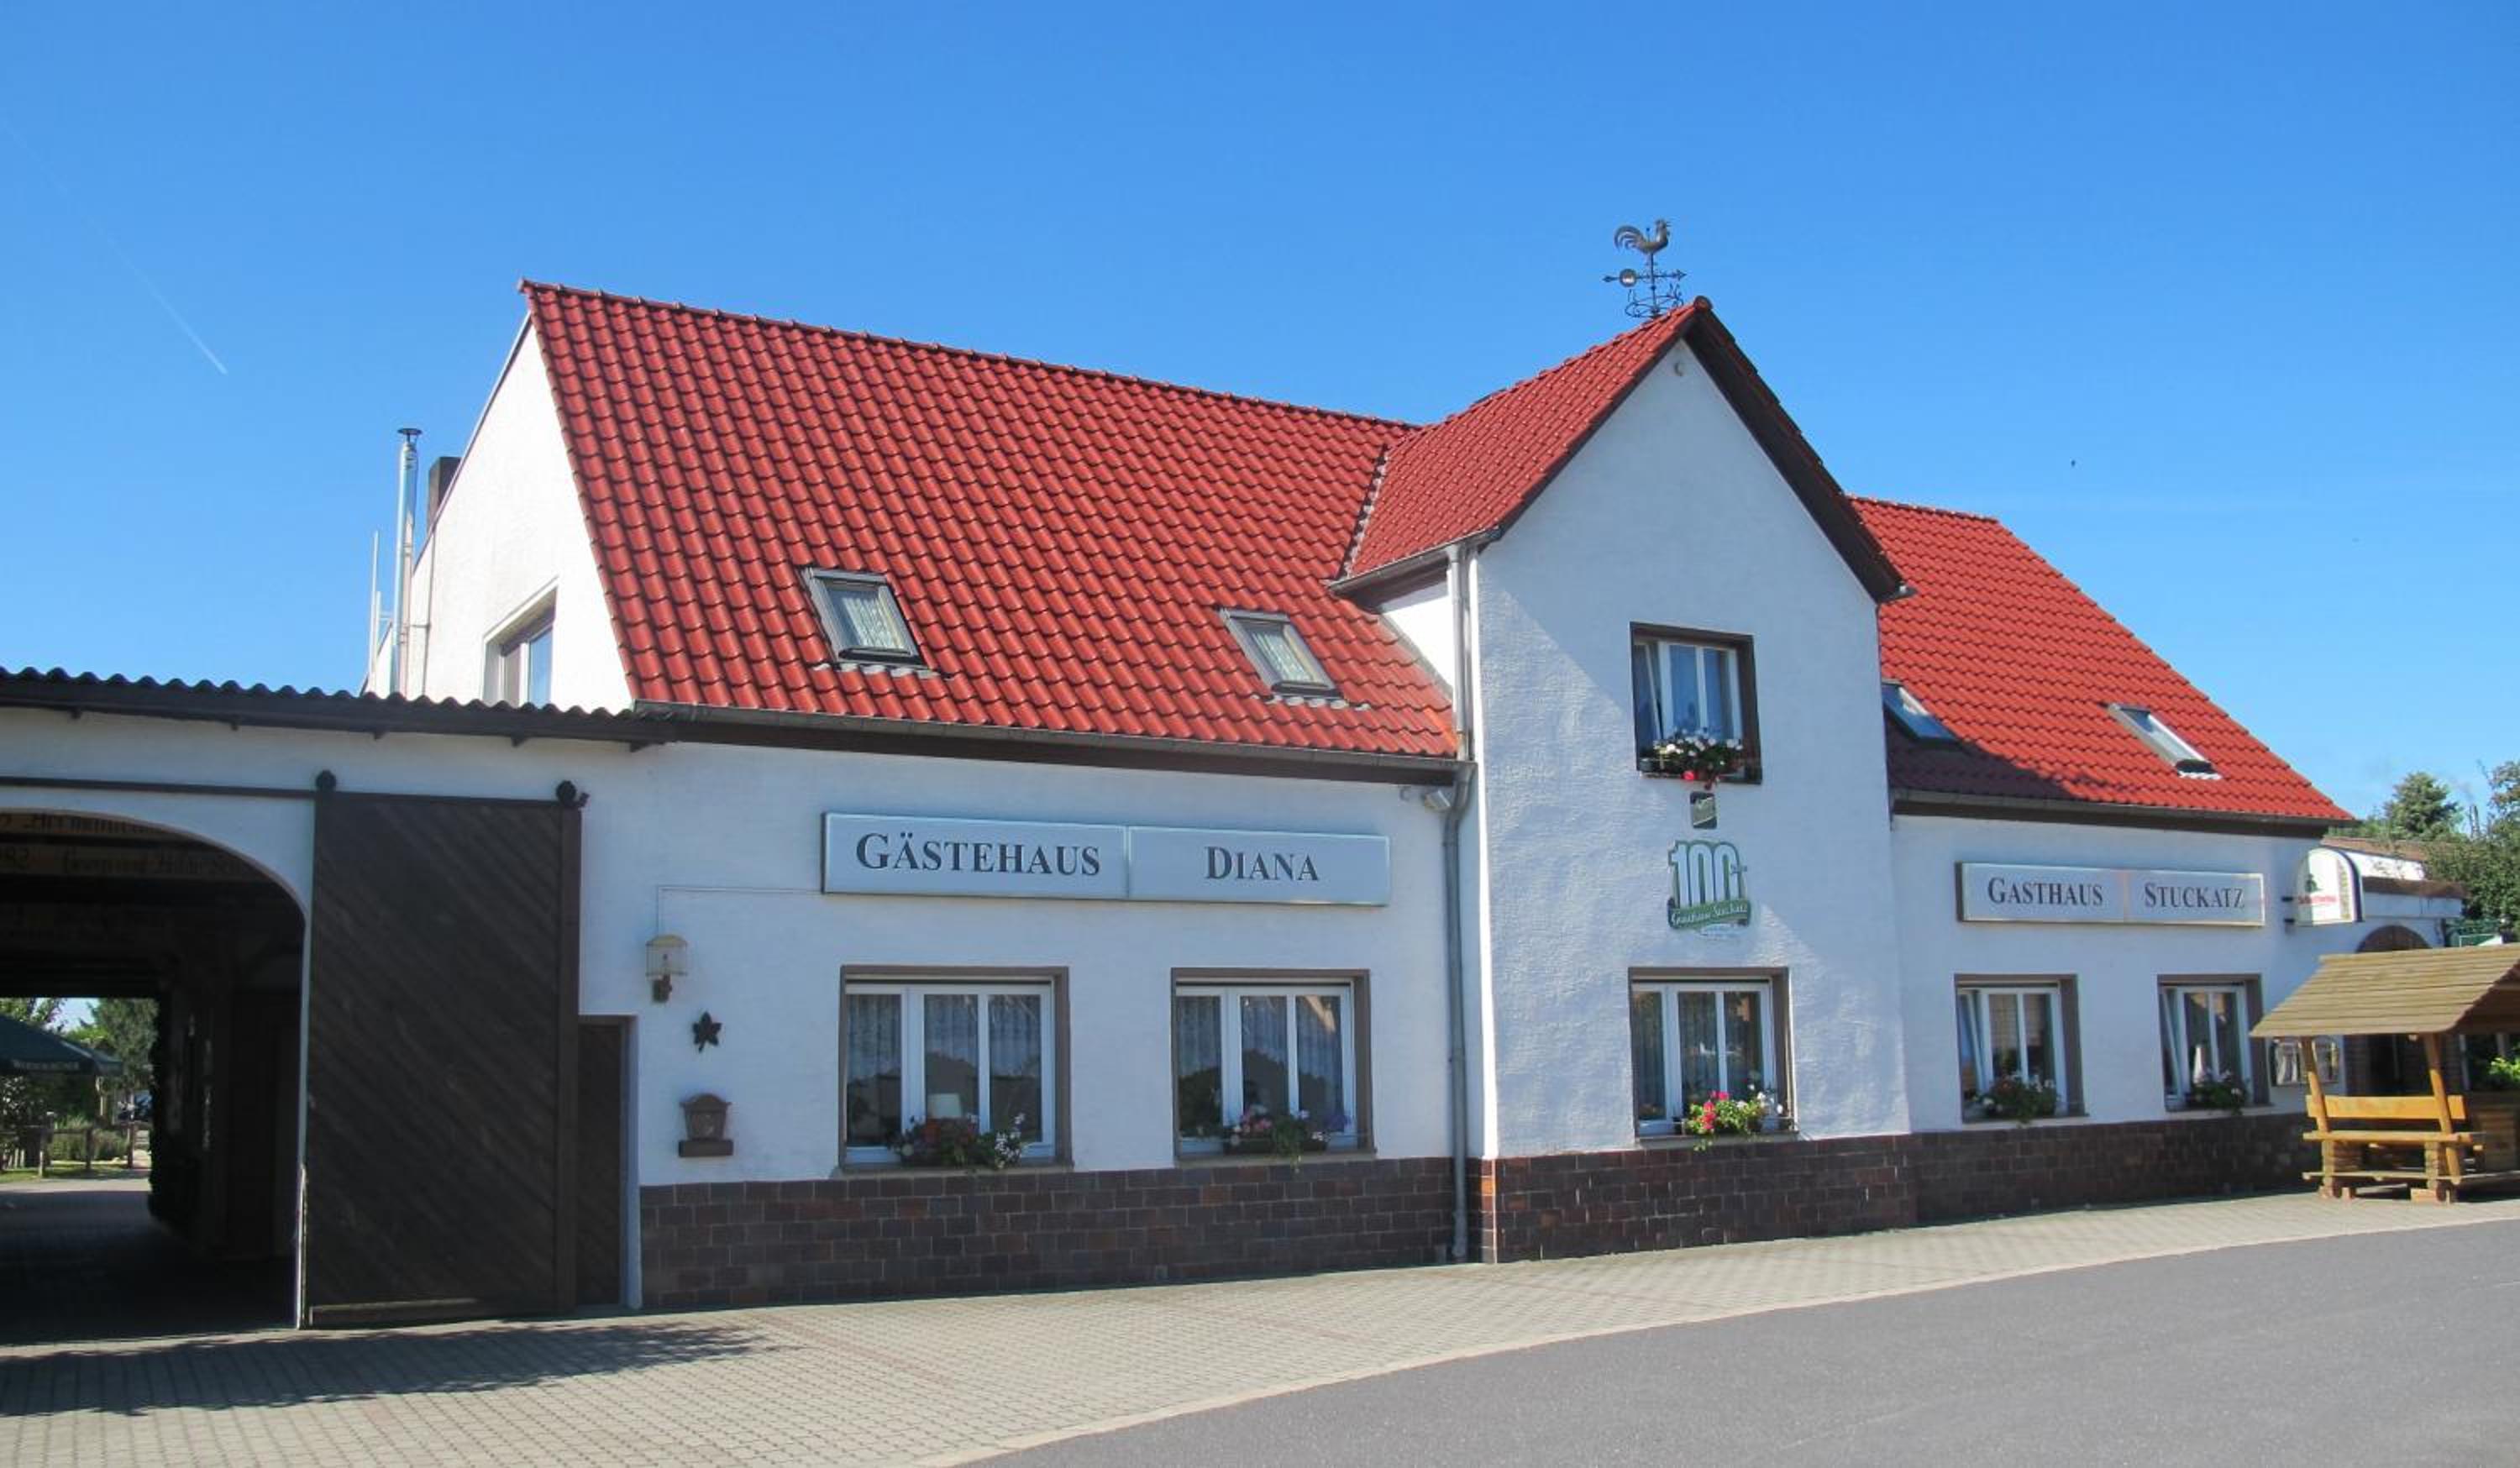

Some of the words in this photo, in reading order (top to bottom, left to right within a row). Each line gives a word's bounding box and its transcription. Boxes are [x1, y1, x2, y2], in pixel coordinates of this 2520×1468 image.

[855, 831, 1100, 876] GÄSTEHAUS
[1205, 845, 1320, 881] DIANA
[1670, 841, 1741, 908] 100
[1987, 877, 2103, 906] GASTHAUS
[2144, 882, 2245, 909] STUCKATZ
